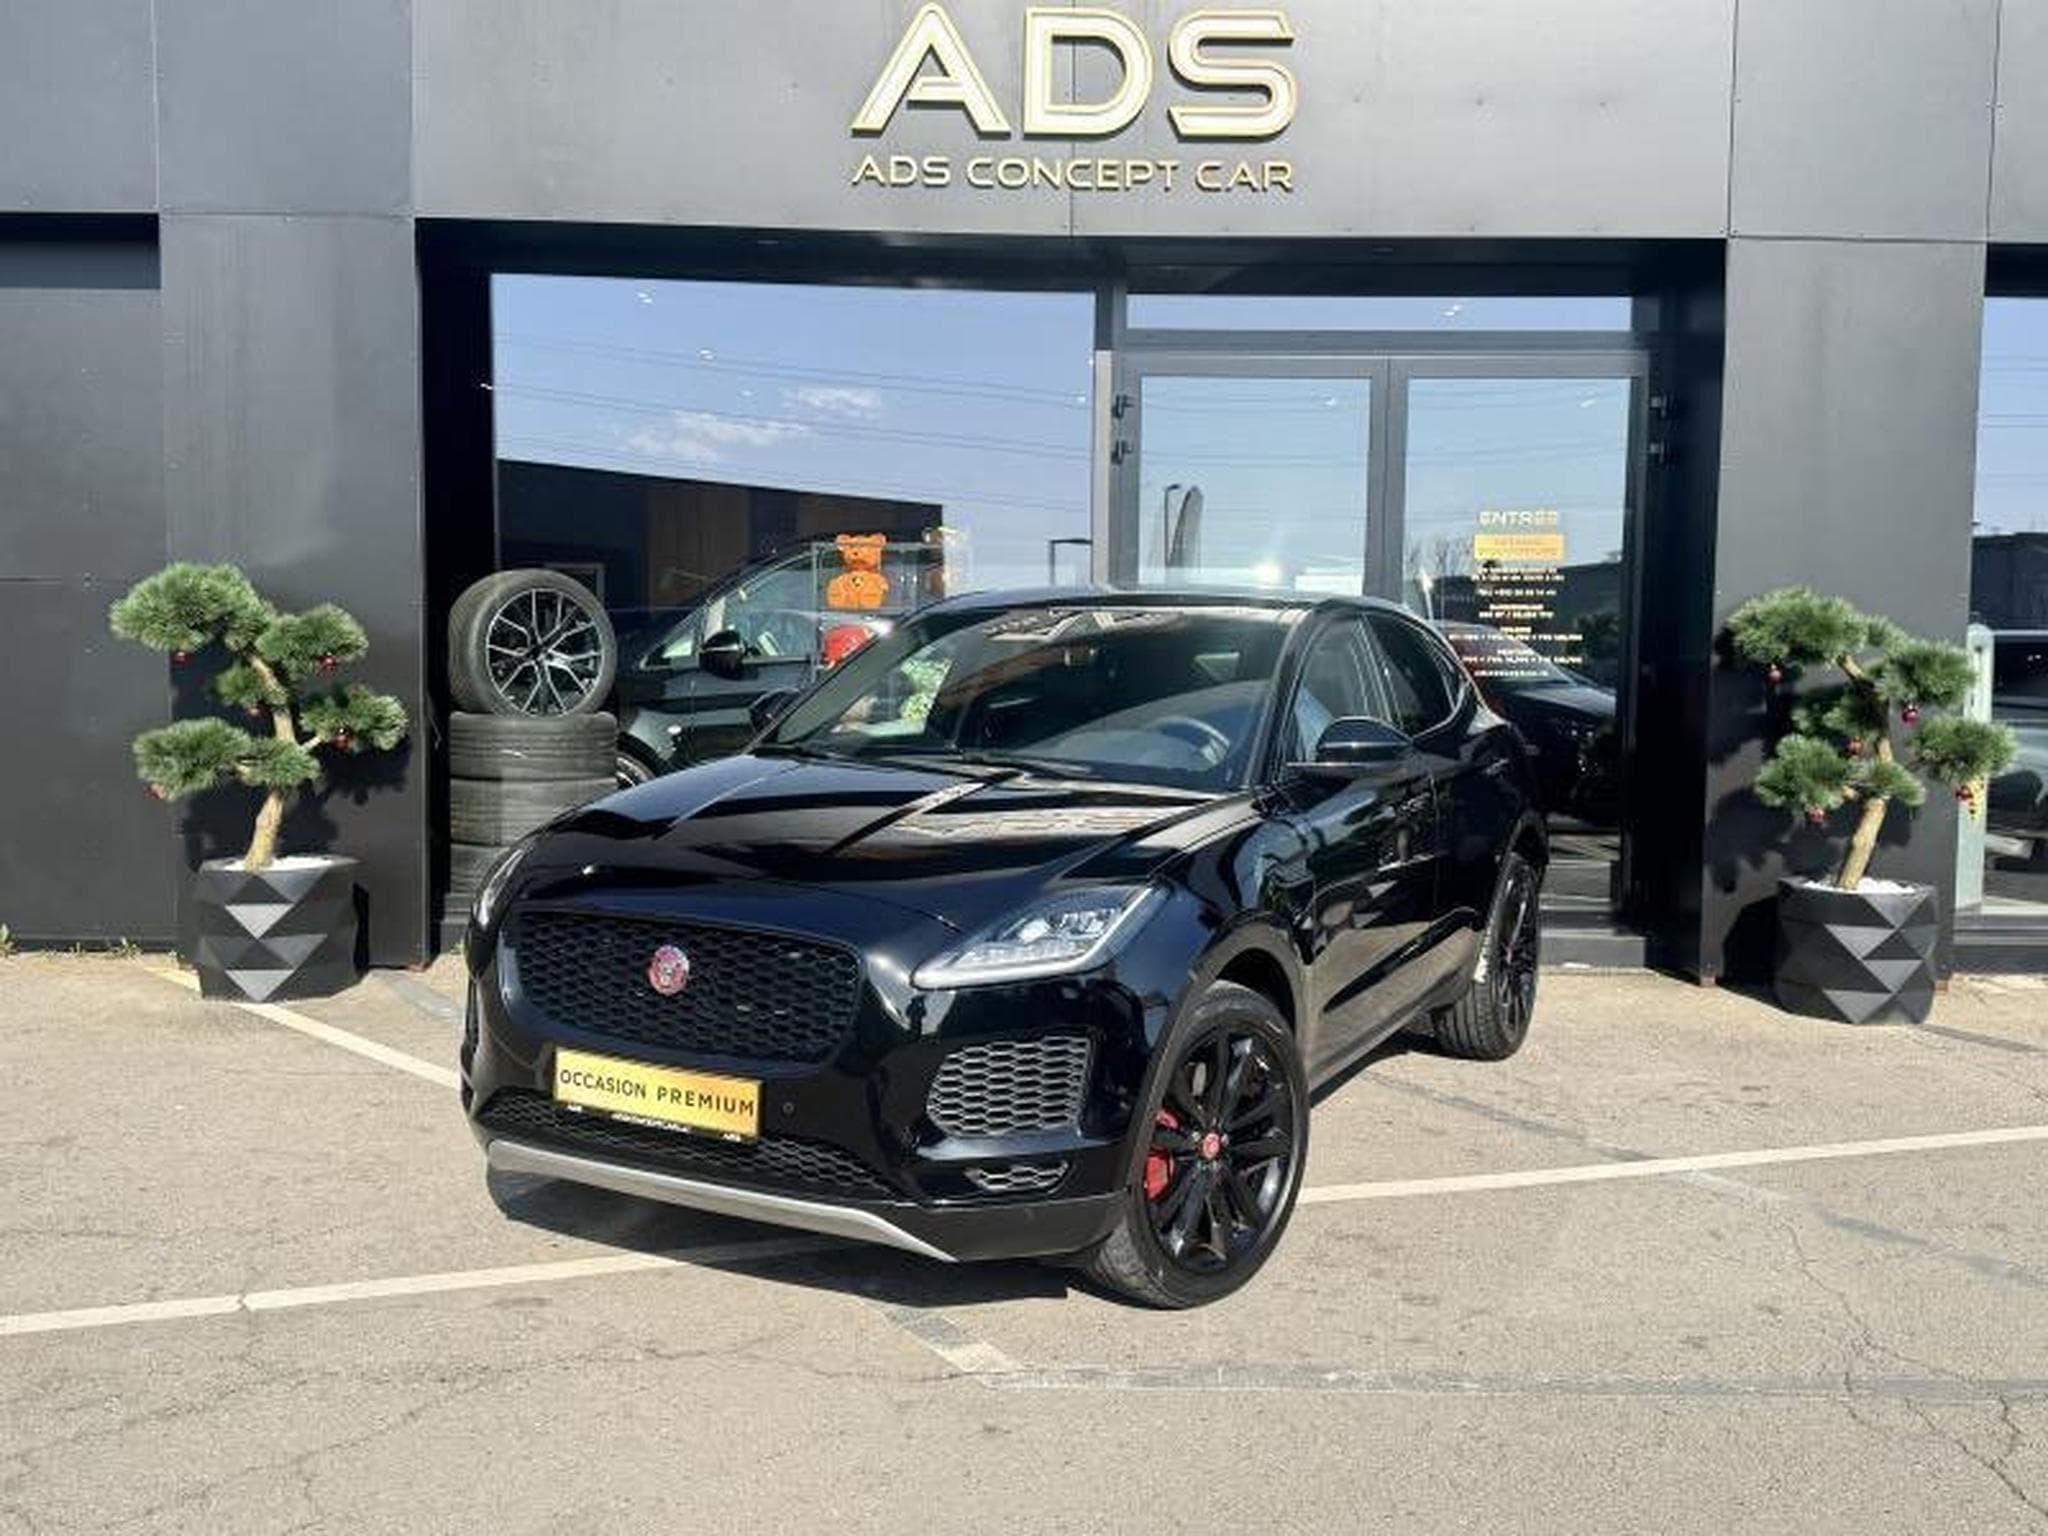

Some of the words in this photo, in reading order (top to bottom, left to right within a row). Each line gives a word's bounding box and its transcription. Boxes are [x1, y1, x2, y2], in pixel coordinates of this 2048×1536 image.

[851, 1, 1298, 141] ADS
[852, 155, 951, 188] ADS
[966, 157, 1179, 191] CONCEPT
[1195, 160, 1294, 191] CAR
[559, 1068, 648, 1099] OCCASION
[656, 1085, 755, 1117] PREMIUM
